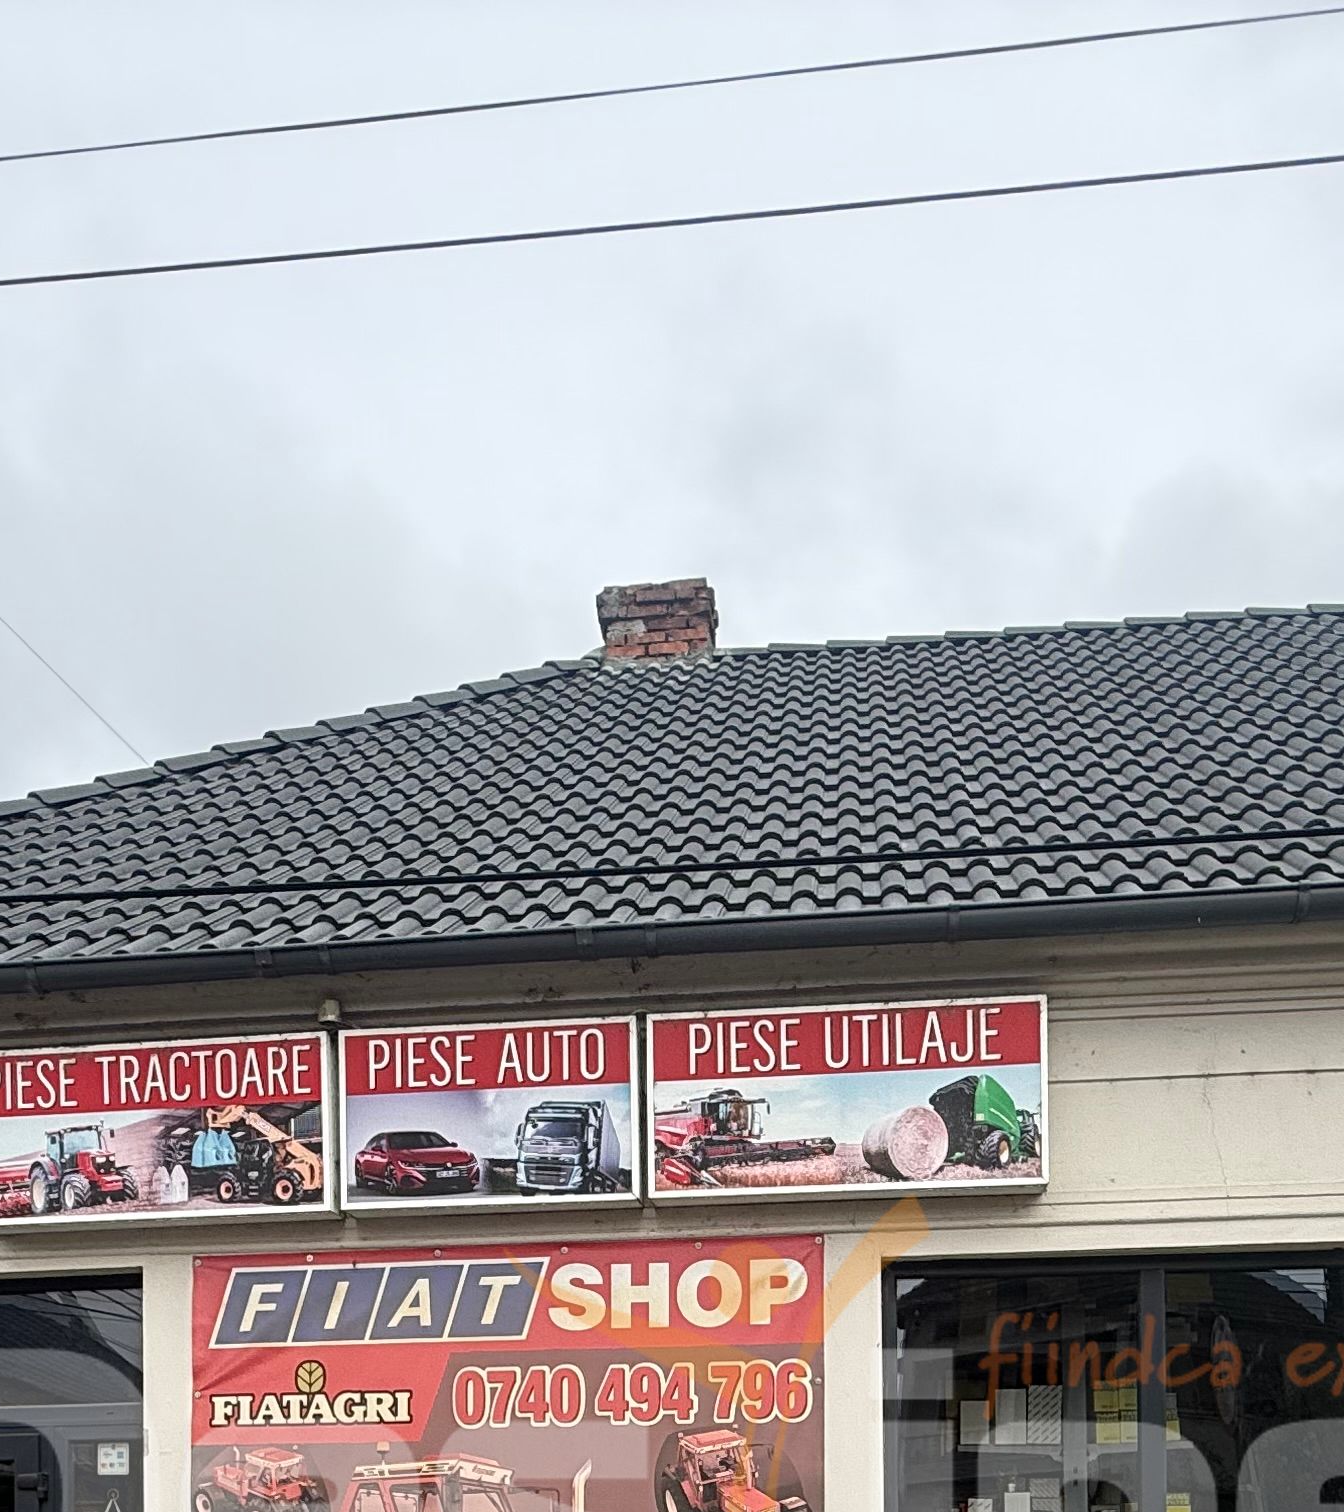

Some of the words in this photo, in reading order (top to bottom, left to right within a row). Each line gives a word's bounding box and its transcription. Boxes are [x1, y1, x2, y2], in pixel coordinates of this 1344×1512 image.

[367, 1034, 476, 1090] PIESE
[497, 1028, 605, 1084] AUTO
[688, 1017, 802, 1075] PIESE
[824, 1007, 1002, 1069] UTILAJE
[94, 1044, 312, 1105] TRACTOARE
[236, 1273, 524, 1335] FIAT
[547, 1258, 809, 1332] SHOP
[210, 1389, 413, 1427] FIATAGRI
[452, 1363, 586, 1429] 0740
[594, 1361, 699, 1427] 494
[707, 1358, 814, 1424] 796
